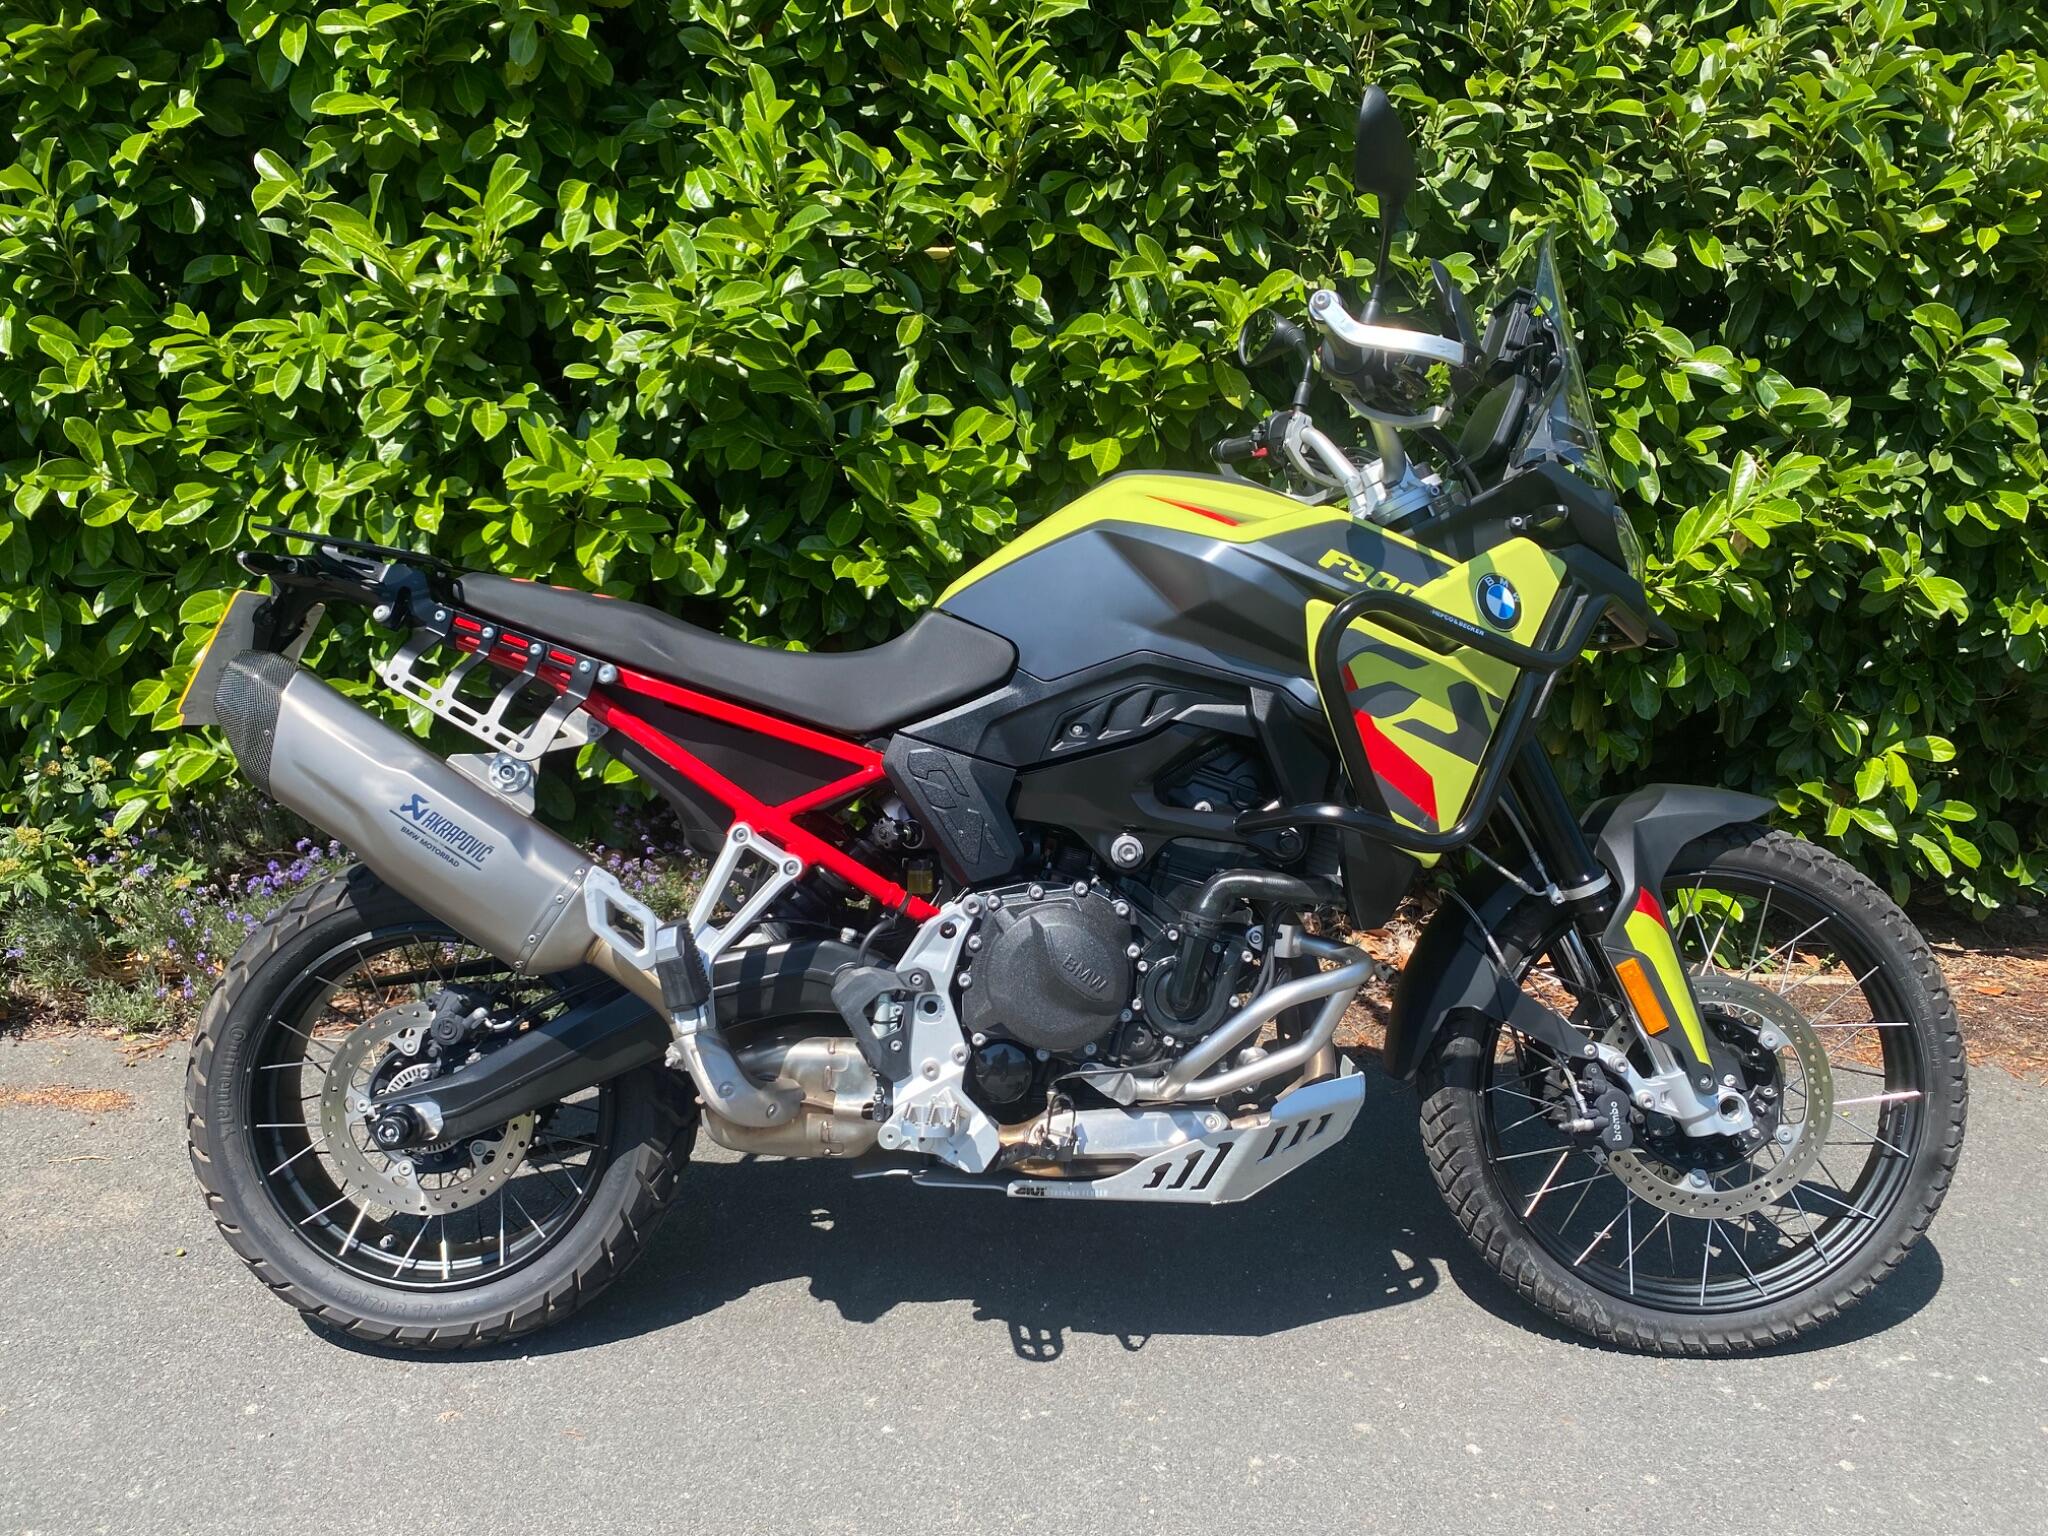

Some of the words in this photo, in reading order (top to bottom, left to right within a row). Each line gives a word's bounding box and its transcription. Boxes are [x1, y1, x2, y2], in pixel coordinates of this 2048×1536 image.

[400, 826, 420, 841] BMW
[419, 838, 460, 868] MOTORRAD
[1062, 953, 1108, 993] BMW
[1609, 1101, 1623, 1142] brembo
